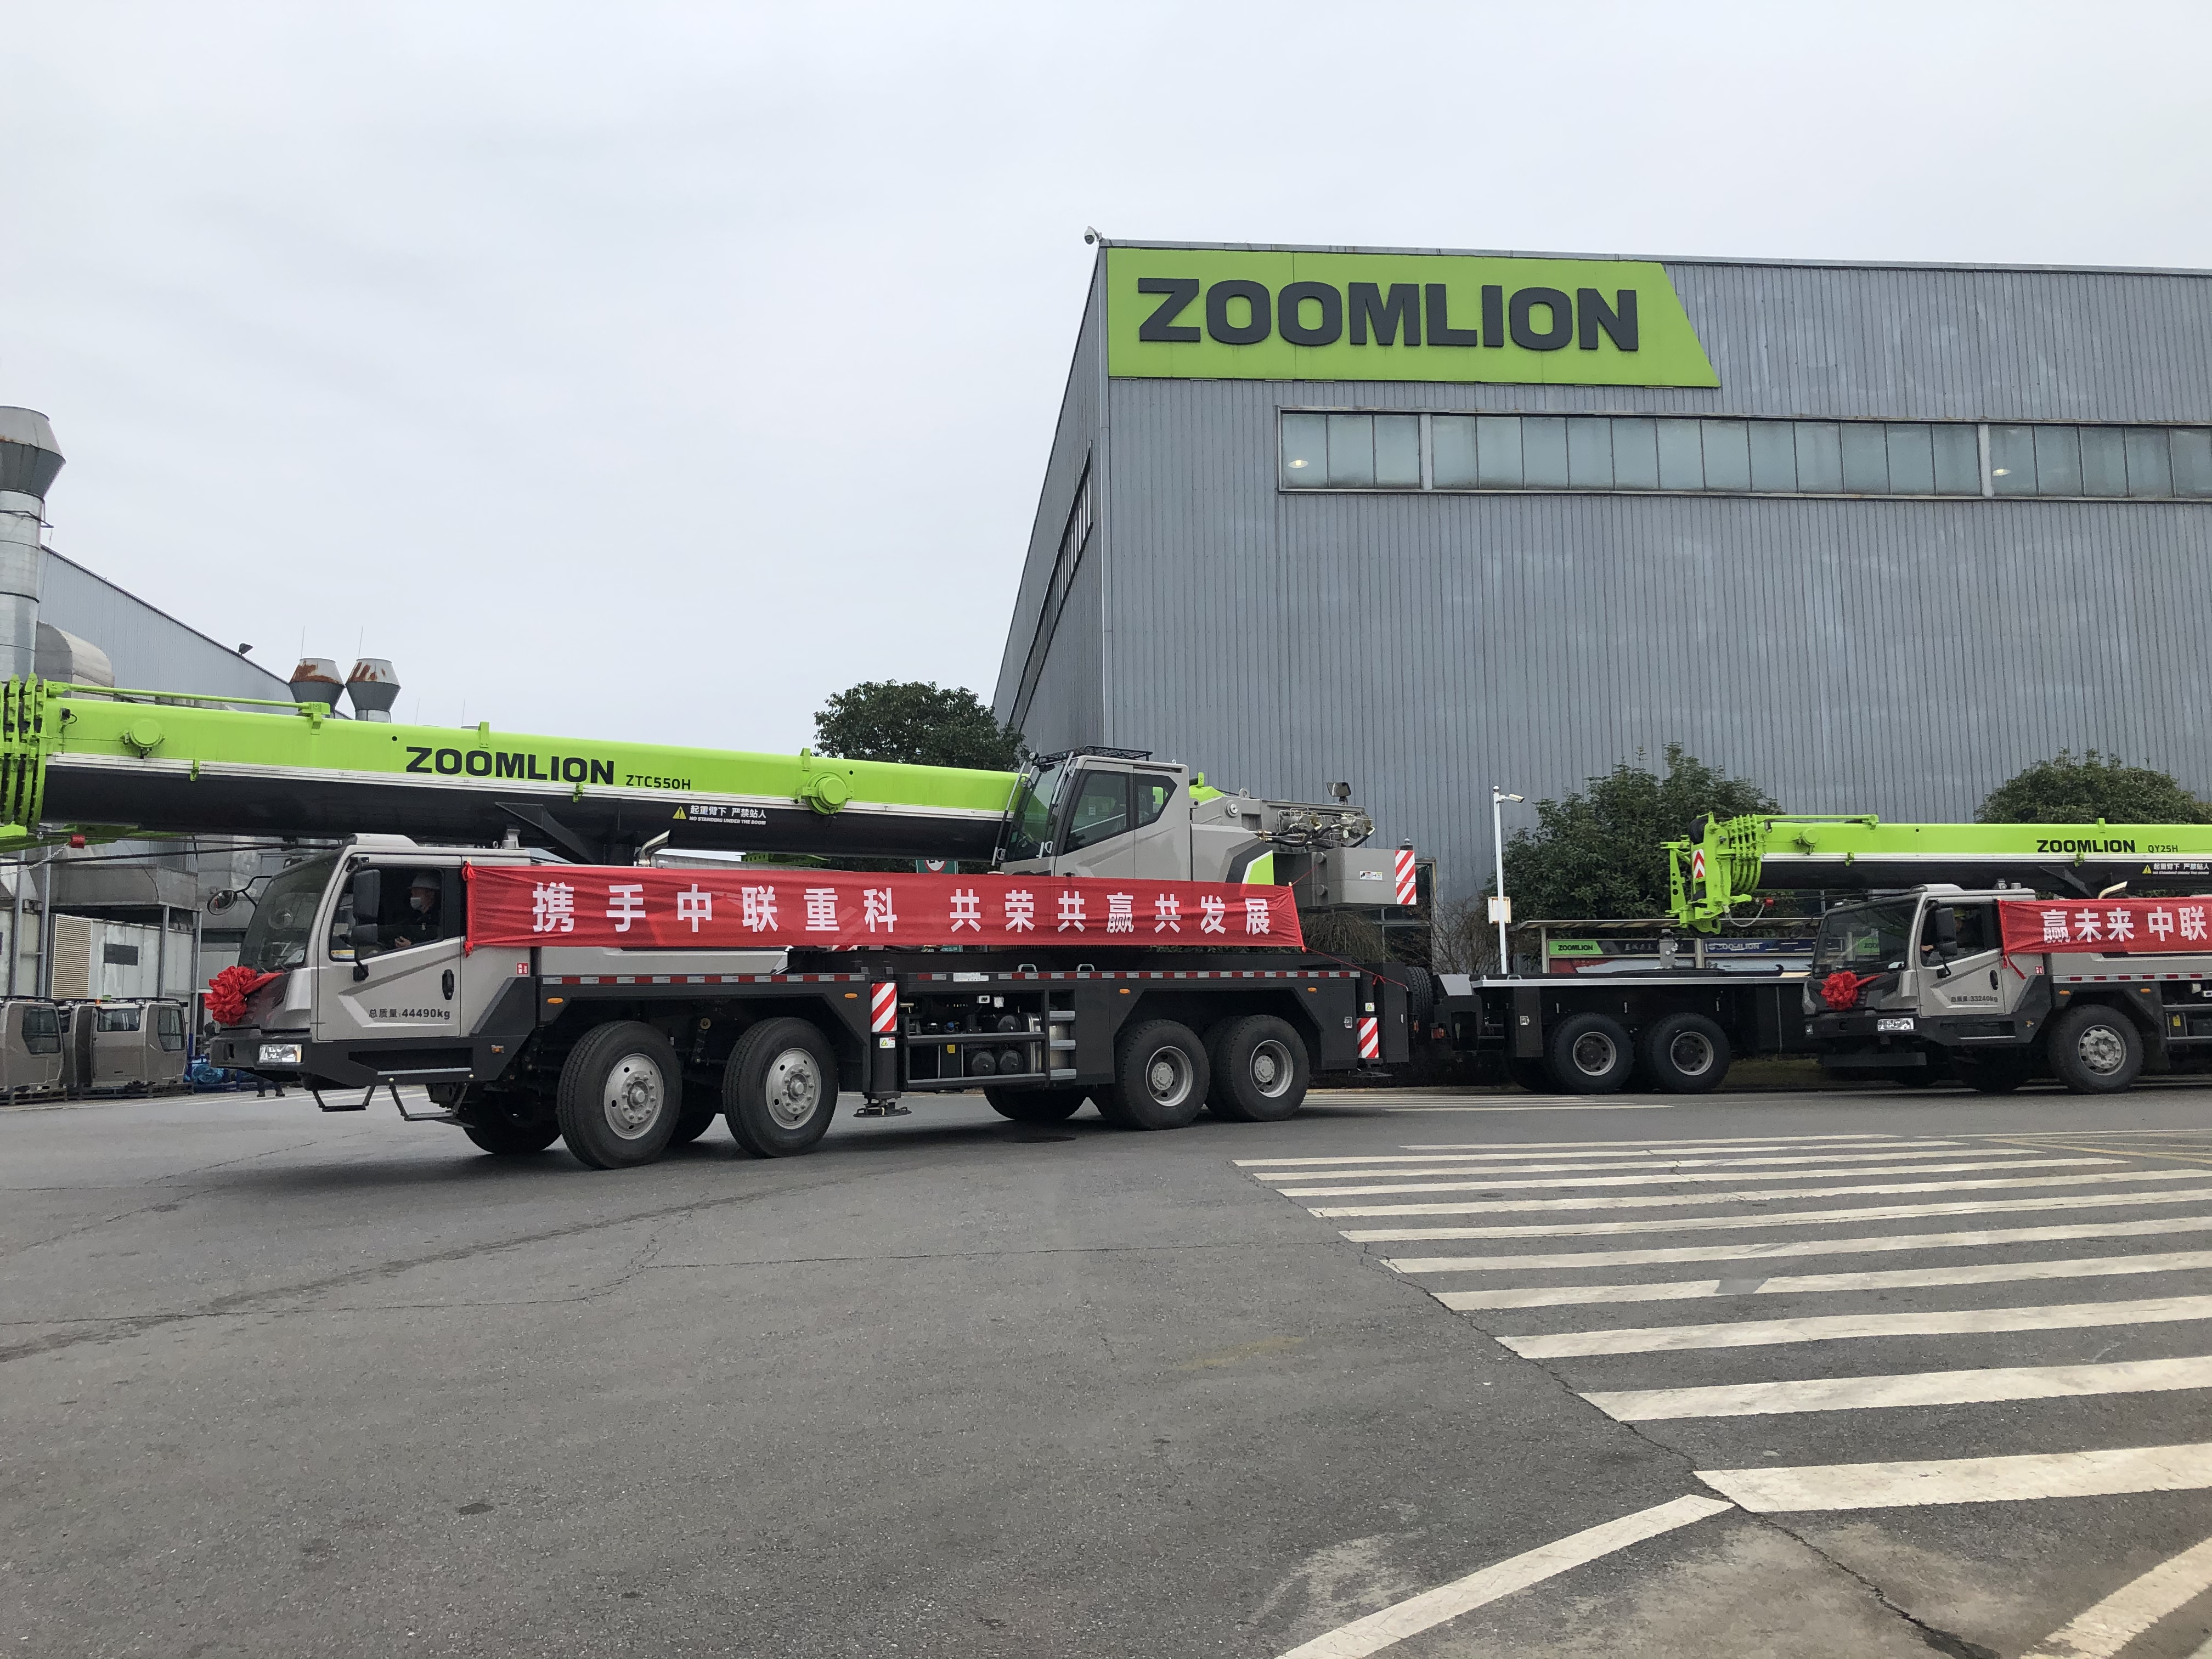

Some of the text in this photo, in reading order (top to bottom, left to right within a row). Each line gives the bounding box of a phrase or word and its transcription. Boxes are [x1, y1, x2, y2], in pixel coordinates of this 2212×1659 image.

[1138, 278, 1639, 351] ZOOMLION
[406, 746, 691, 790] ZOOMLION ZTC550H
[690, 805, 767, 819] 起重臂下 严禁站人
[2036, 840, 2179, 854] ZOOMLION QY25H
[532, 882, 1271, 935] 携手中联重科 共荣共赢共发展
[2040, 906, 2208, 943] 赢未来 中联
